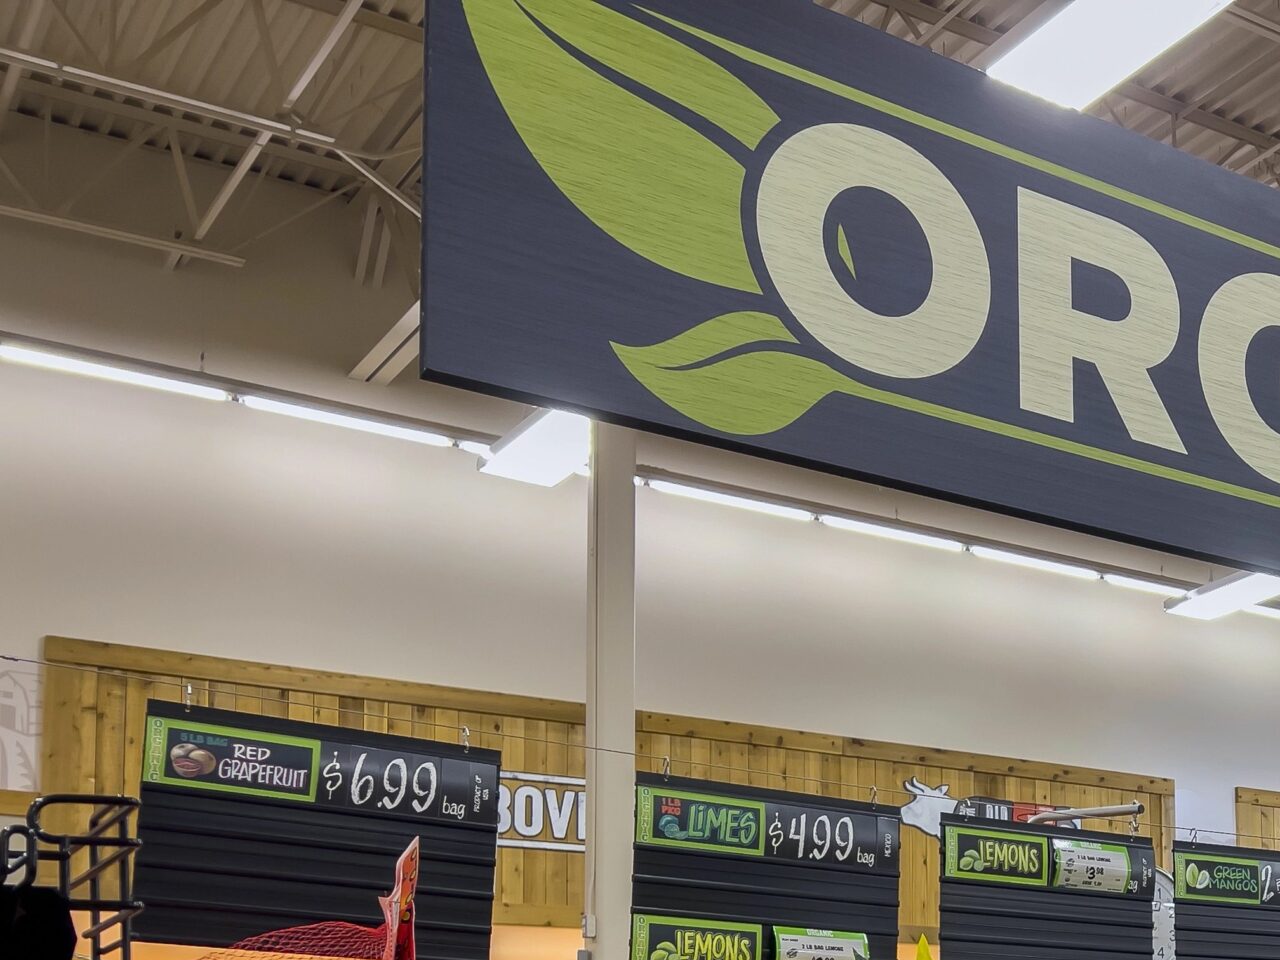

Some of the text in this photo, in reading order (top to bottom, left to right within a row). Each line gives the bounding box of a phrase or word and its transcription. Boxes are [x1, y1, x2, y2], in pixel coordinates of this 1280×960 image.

[180, 733, 228, 749] 5 LB BAG
[232, 744, 271, 761] RED
[217, 758, 307, 788] GRAPEFRUIT
[322, 751, 466, 819] $6.99 bag
[768, 812, 875, 868] $4.99 bag
[884, 833, 893, 857] MEXICO
[979, 840, 1039, 873] LEMONS
[1213, 865, 1250, 880] GREEN
[1261, 865, 1274, 902] 2
[1128, 881, 1139, 893] ag
[1208, 877, 1258, 893] MANGOS
